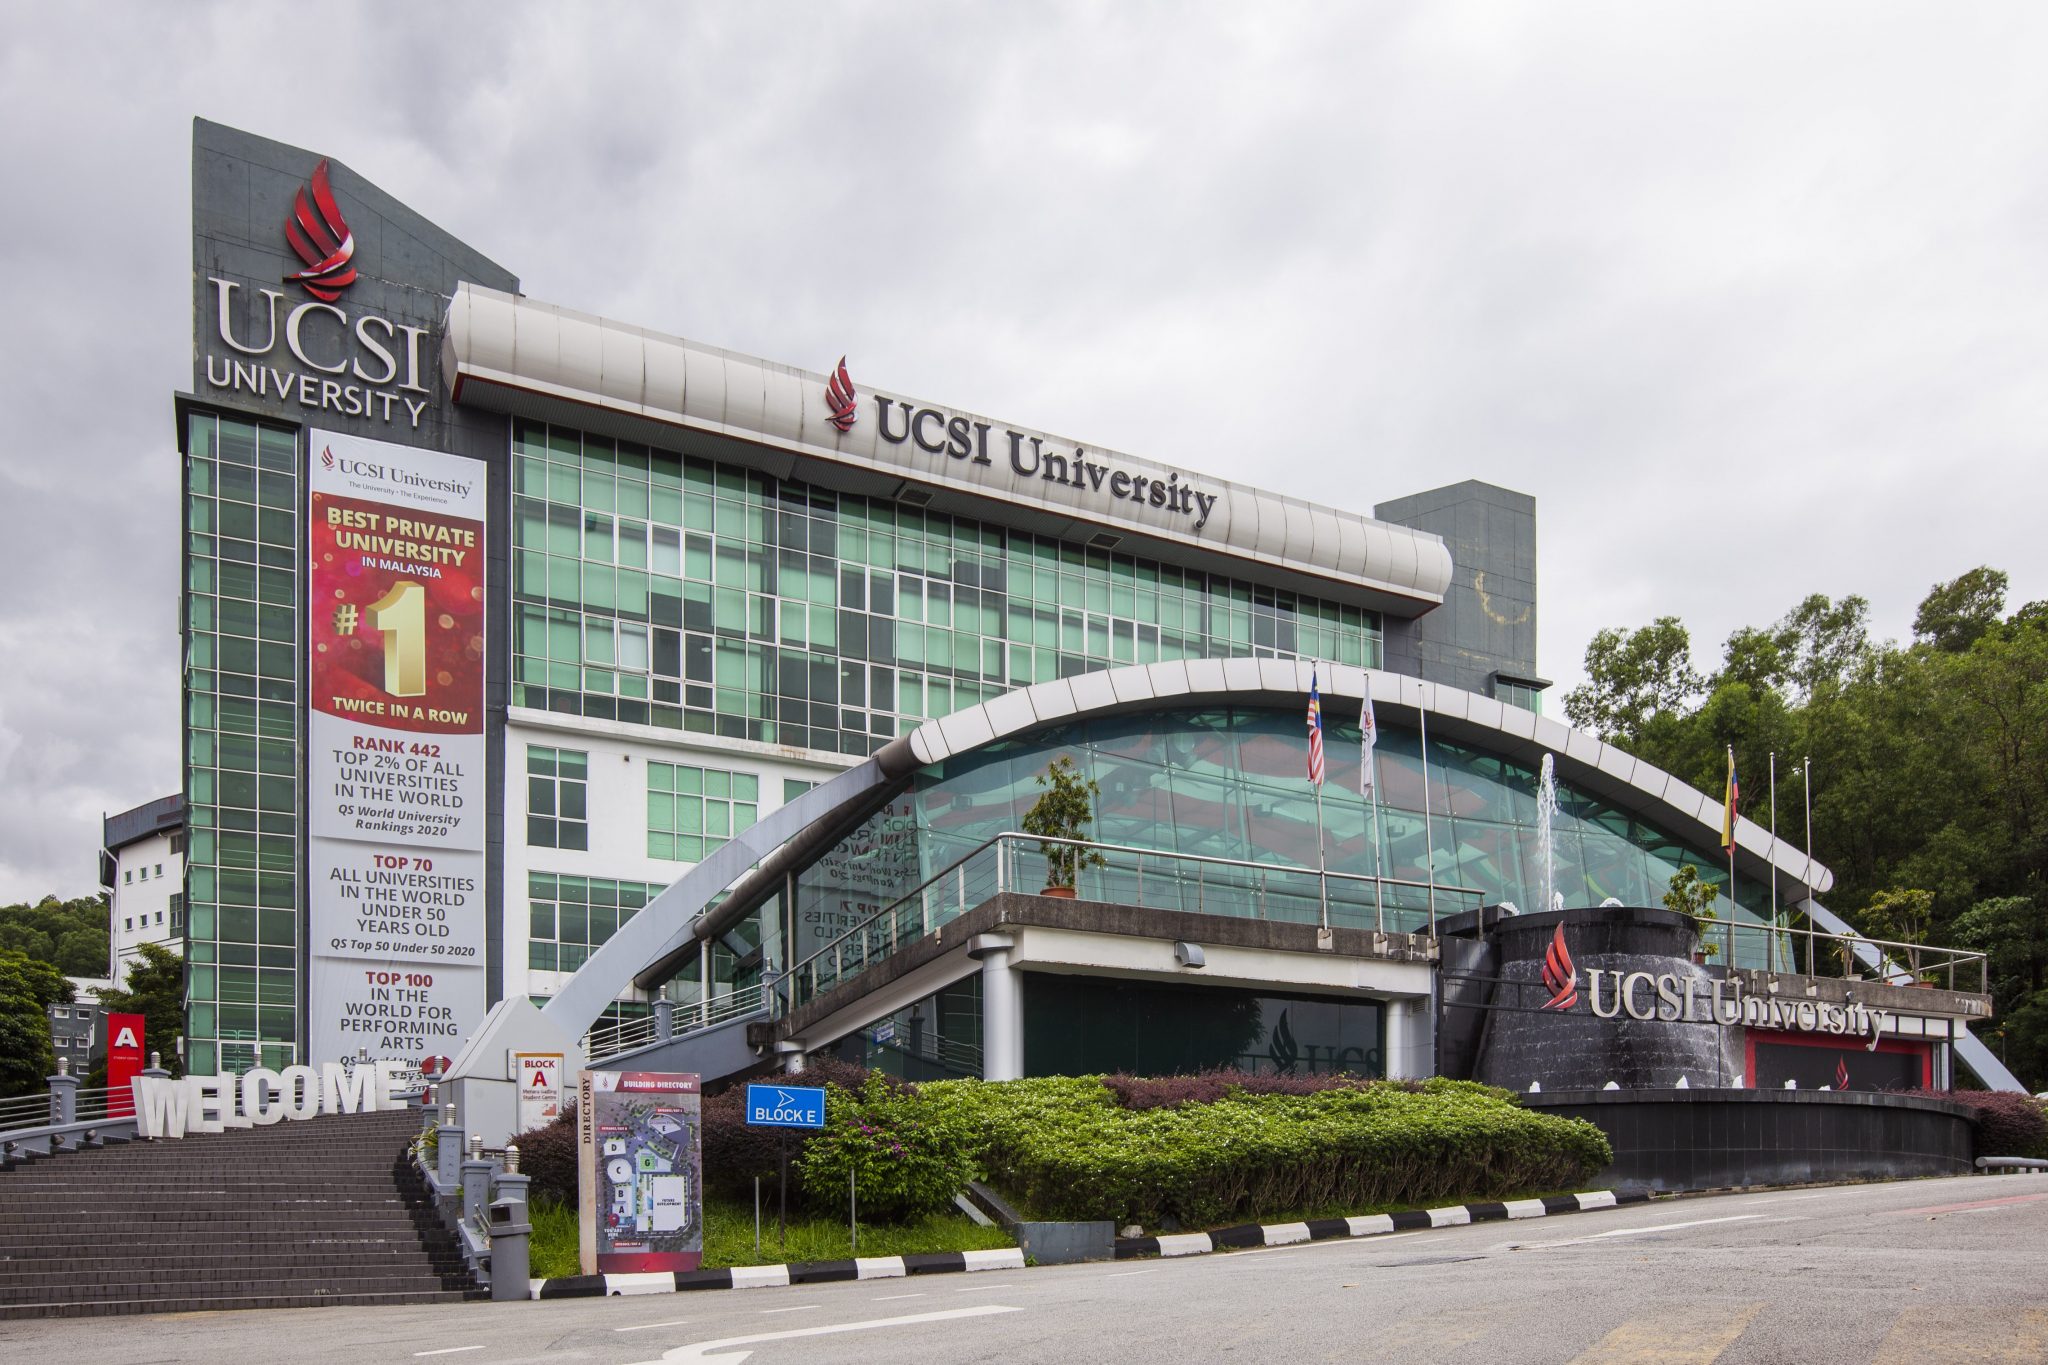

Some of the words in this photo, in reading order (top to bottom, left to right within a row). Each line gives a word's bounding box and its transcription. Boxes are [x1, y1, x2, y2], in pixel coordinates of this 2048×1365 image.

[208, 277, 430, 393] UCSI
[207, 356, 426, 427] UNIVERSITY
[874, 394, 992, 465] UCSI
[1006, 429, 1217, 529] University
[339, 458, 385, 480] UCSI
[390, 467, 471, 499] University
[349, 481, 361, 489] The
[362, 483, 394, 495] University
[400, 490, 412, 498] The
[413, 492, 448, 505] Experience
[327, 506, 380, 531] BEST
[386, 516, 475, 548] PRIVATE
[336, 530, 466, 567] UNIVERSITY
[362, 556, 376, 568] IN
[380, 559, 442, 579] MALAYSIA
[333, 696, 385, 715] TWICE
[390, 703, 409, 718] IN
[412, 706, 425, 720] A
[428, 708, 468, 725] ROW
[353, 735, 405, 754] RANK
[410, 743, 441, 758] 442
[332, 749, 369, 766] TOP
[374, 755, 400, 770] 2%
[405, 758, 428, 773] OF
[433, 761, 465, 777] ALL
[340, 767, 458, 792] UNIVERSITIES
[335, 783, 354, 798] IN
[360, 786, 394, 802] THE
[399, 790, 463, 808] WORLD
[338, 804, 355, 816] QS
[358, 806, 395, 819] World
[397, 810, 461, 828] University
[355, 819, 414, 835] Rankings
[417, 825, 448, 836] 2020
[373, 854, 408, 869] TOP
[412, 858, 433, 872] 70
[330, 867, 361, 882] ALL
[366, 870, 475, 891] UNIVERSITIES
[341, 884, 359, 898] IN
[364, 886, 398, 902] THE
[402, 889, 465, 906] WORLD
[362, 902, 422, 920] UNDER
[426, 908, 446, 921] 50
[357, 918, 410, 935] YEARS
[415, 923, 450, 937] OLD
[331, 938, 347, 950] QS
[350, 939, 372, 952] Top
[375, 941, 390, 951] 50
[393, 942, 429, 954] Under
[430, 944, 445, 955] 50
[447, 945, 475, 956] 2020
[365, 971, 401, 985] TOP
[405, 973, 433, 987] 100
[371, 987, 390, 1001] IN
[396, 988, 428, 1003] THE
[345, 1002, 412, 1018] WORLD
[418, 1005, 452, 1020] FOR
[1585, 968, 1699, 1022] UCSI
[1708, 977, 1887, 1052] University
[114, 1027, 139, 1048] A
[340, 1018, 458, 1036] PERFORMING
[380, 1036, 424, 1050] ARTS
[524, 1060, 555, 1068] BLOCK
[532, 1071, 547, 1086] A
[623, 1080, 655, 1088] BUILDING
[657, 1081, 693, 1089] DIRECTORY
[130, 1060, 408, 1138] WELCOME
[582, 1078, 591, 1144] DIRECTORY
[755, 1107, 803, 1122] BLOCK
[806, 1110, 816, 1123] E
[616, 1166, 622, 1174] C
